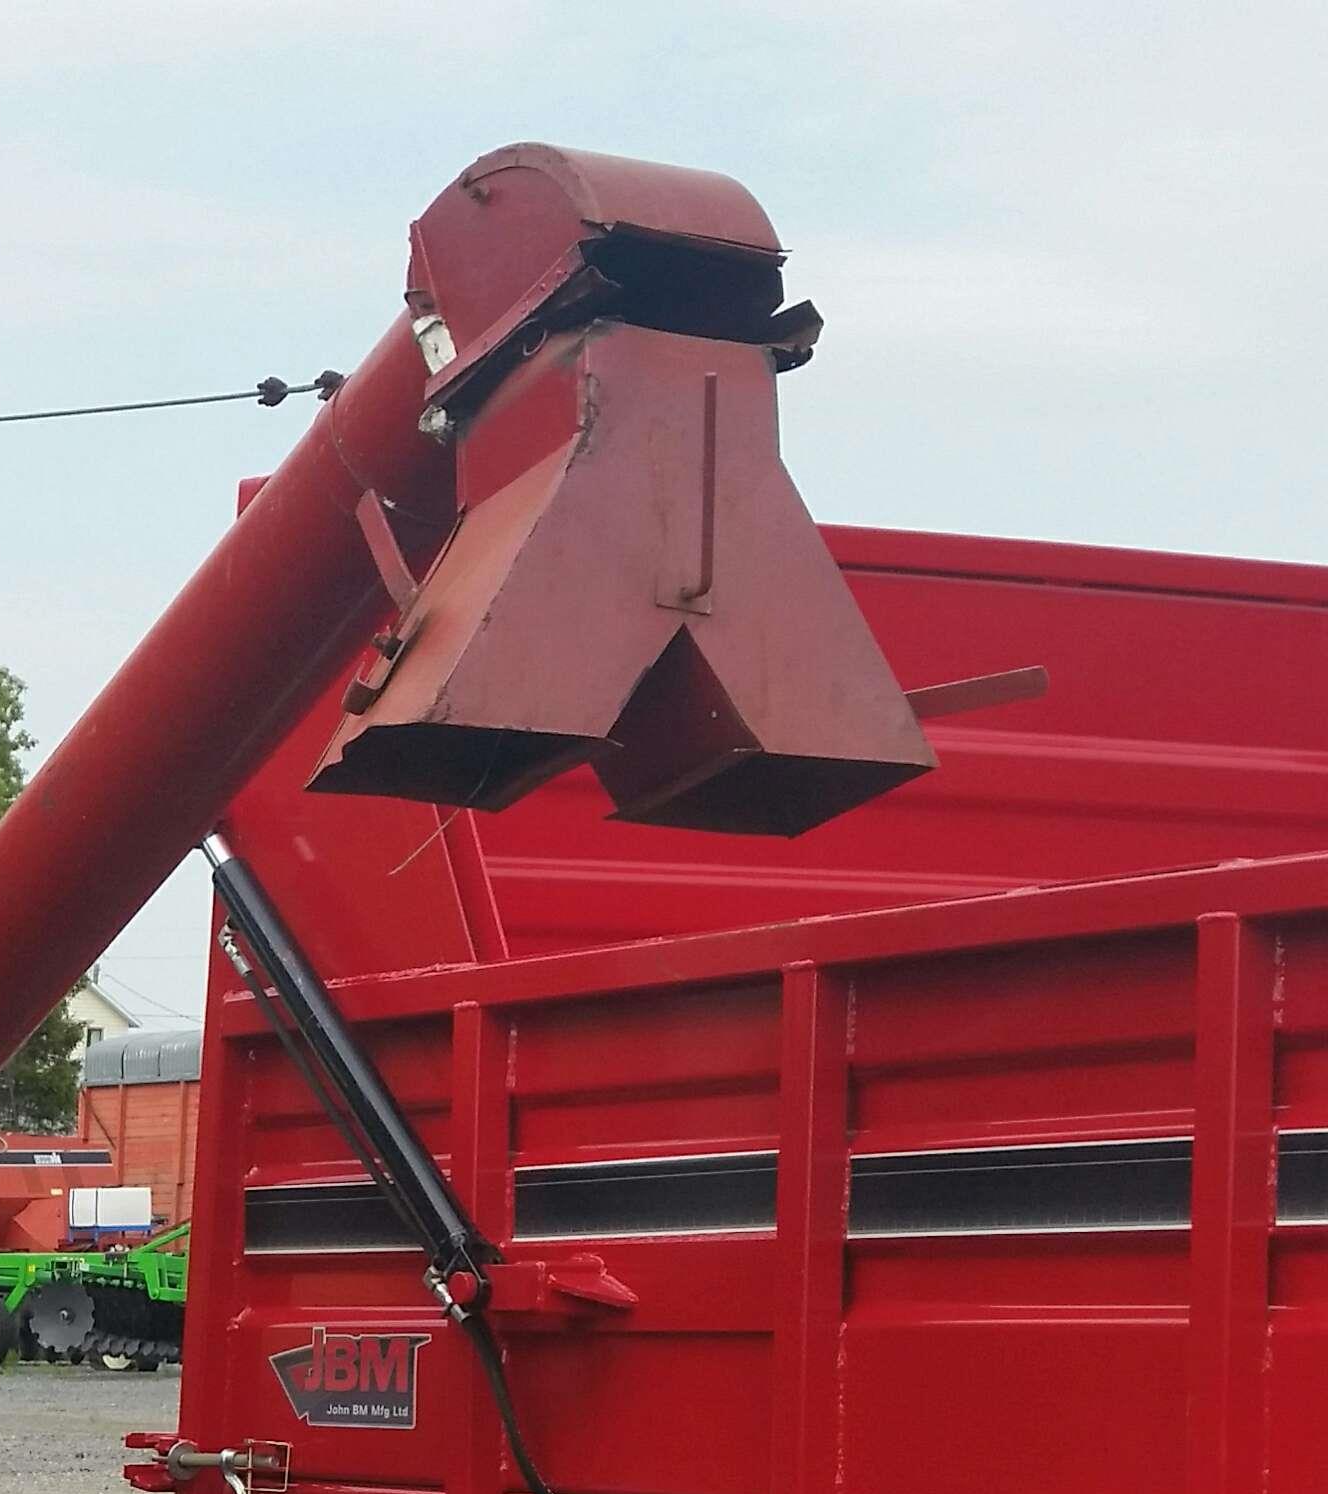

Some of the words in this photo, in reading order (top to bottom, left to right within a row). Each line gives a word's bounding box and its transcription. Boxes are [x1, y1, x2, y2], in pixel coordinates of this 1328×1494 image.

[290, 1330, 411, 1393] JBM
[326, 1404, 350, 1415] John
[352, 1404, 368, 1415] BM
[371, 1405, 390, 1418] Mfg
[393, 1405, 409, 1417] Ltd
